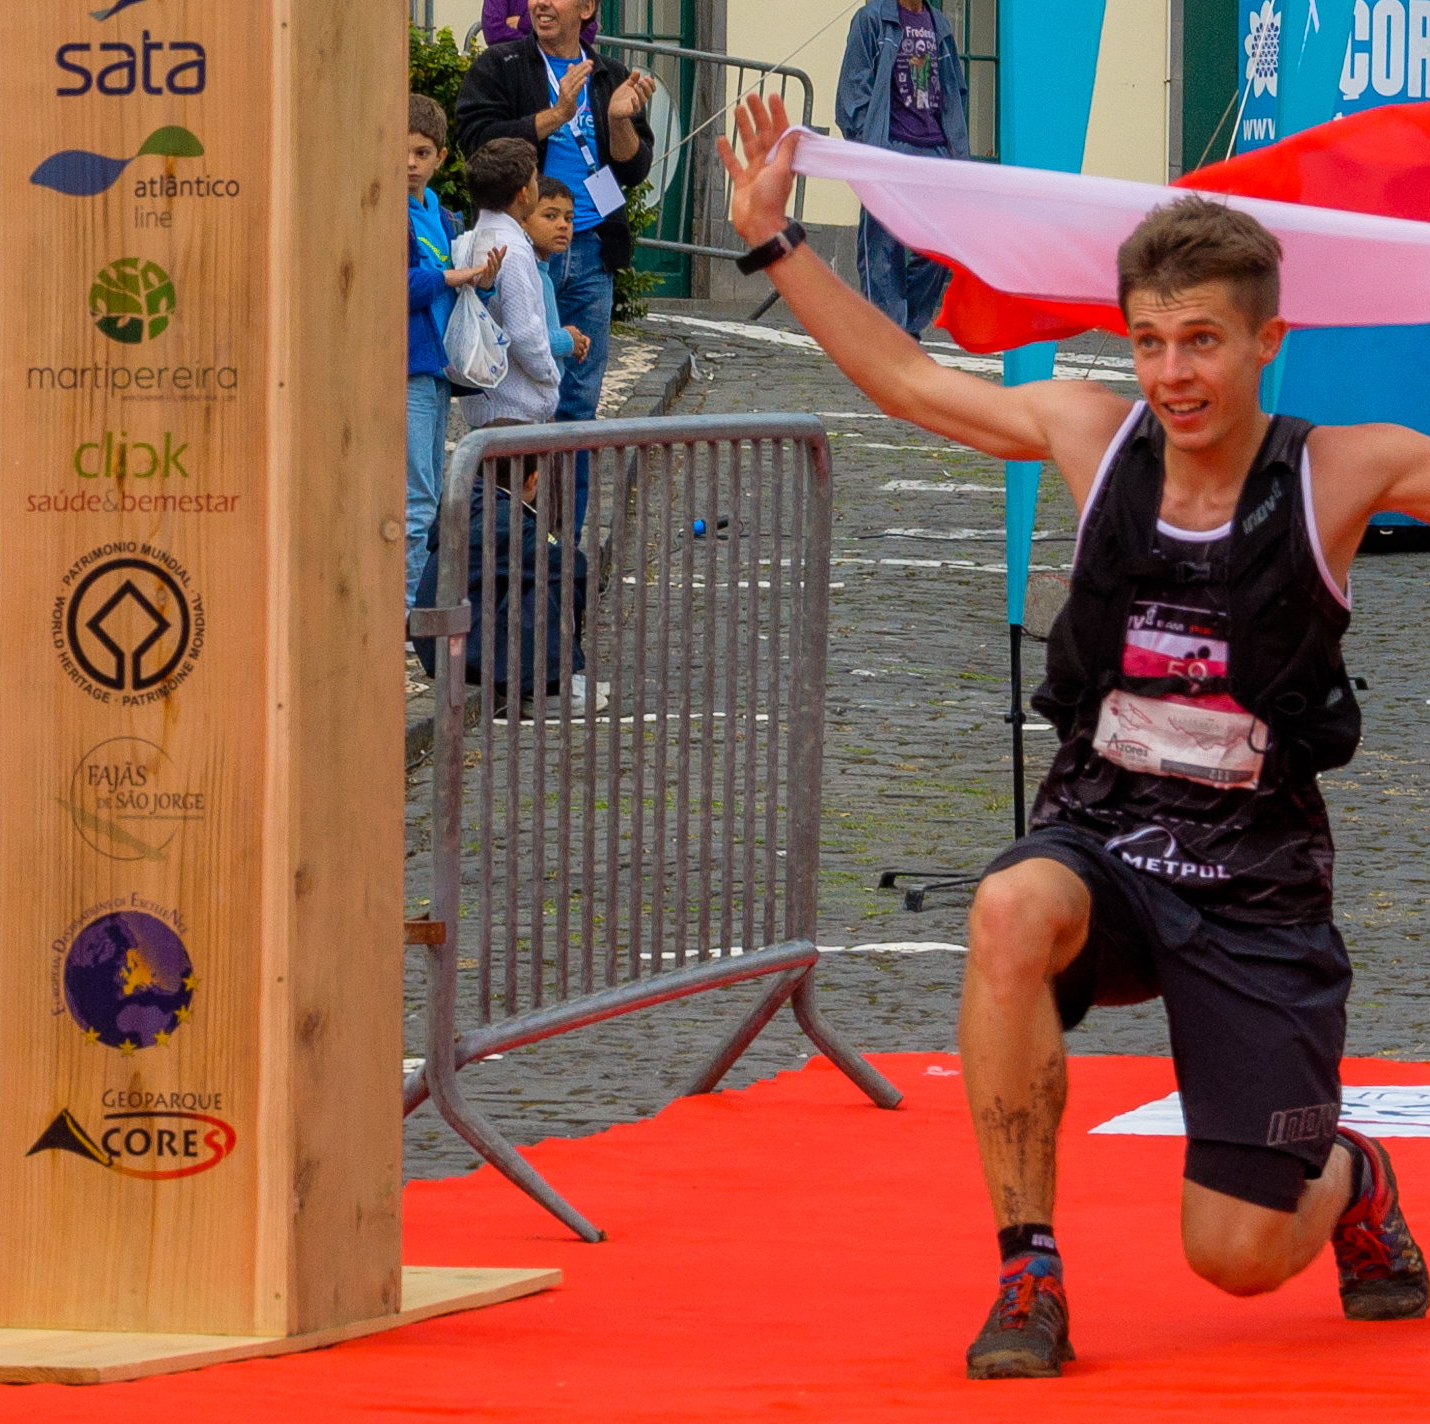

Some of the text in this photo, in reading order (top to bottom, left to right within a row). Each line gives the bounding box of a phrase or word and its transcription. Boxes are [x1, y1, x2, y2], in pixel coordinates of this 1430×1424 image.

[54, 29, 207, 97] sata
[133, 174, 240, 198] atlântico
[133, 205, 173, 229] line
[26, 359, 239, 399] martipereira
[61, 540, 192, 588] PATRIMONIO MUNDIAL
[190, 593, 206, 661] MONDIAL
[50, 594, 112, 705] WORLD HERITAGE
[121, 661, 195, 707] PATRIMOINE
[86, 762, 148, 794] FAJÃS
[114, 791, 149, 811] SÃO
[148, 792, 205, 815] JORGE
[101, 1087, 224, 1112] GEOPARQUE
